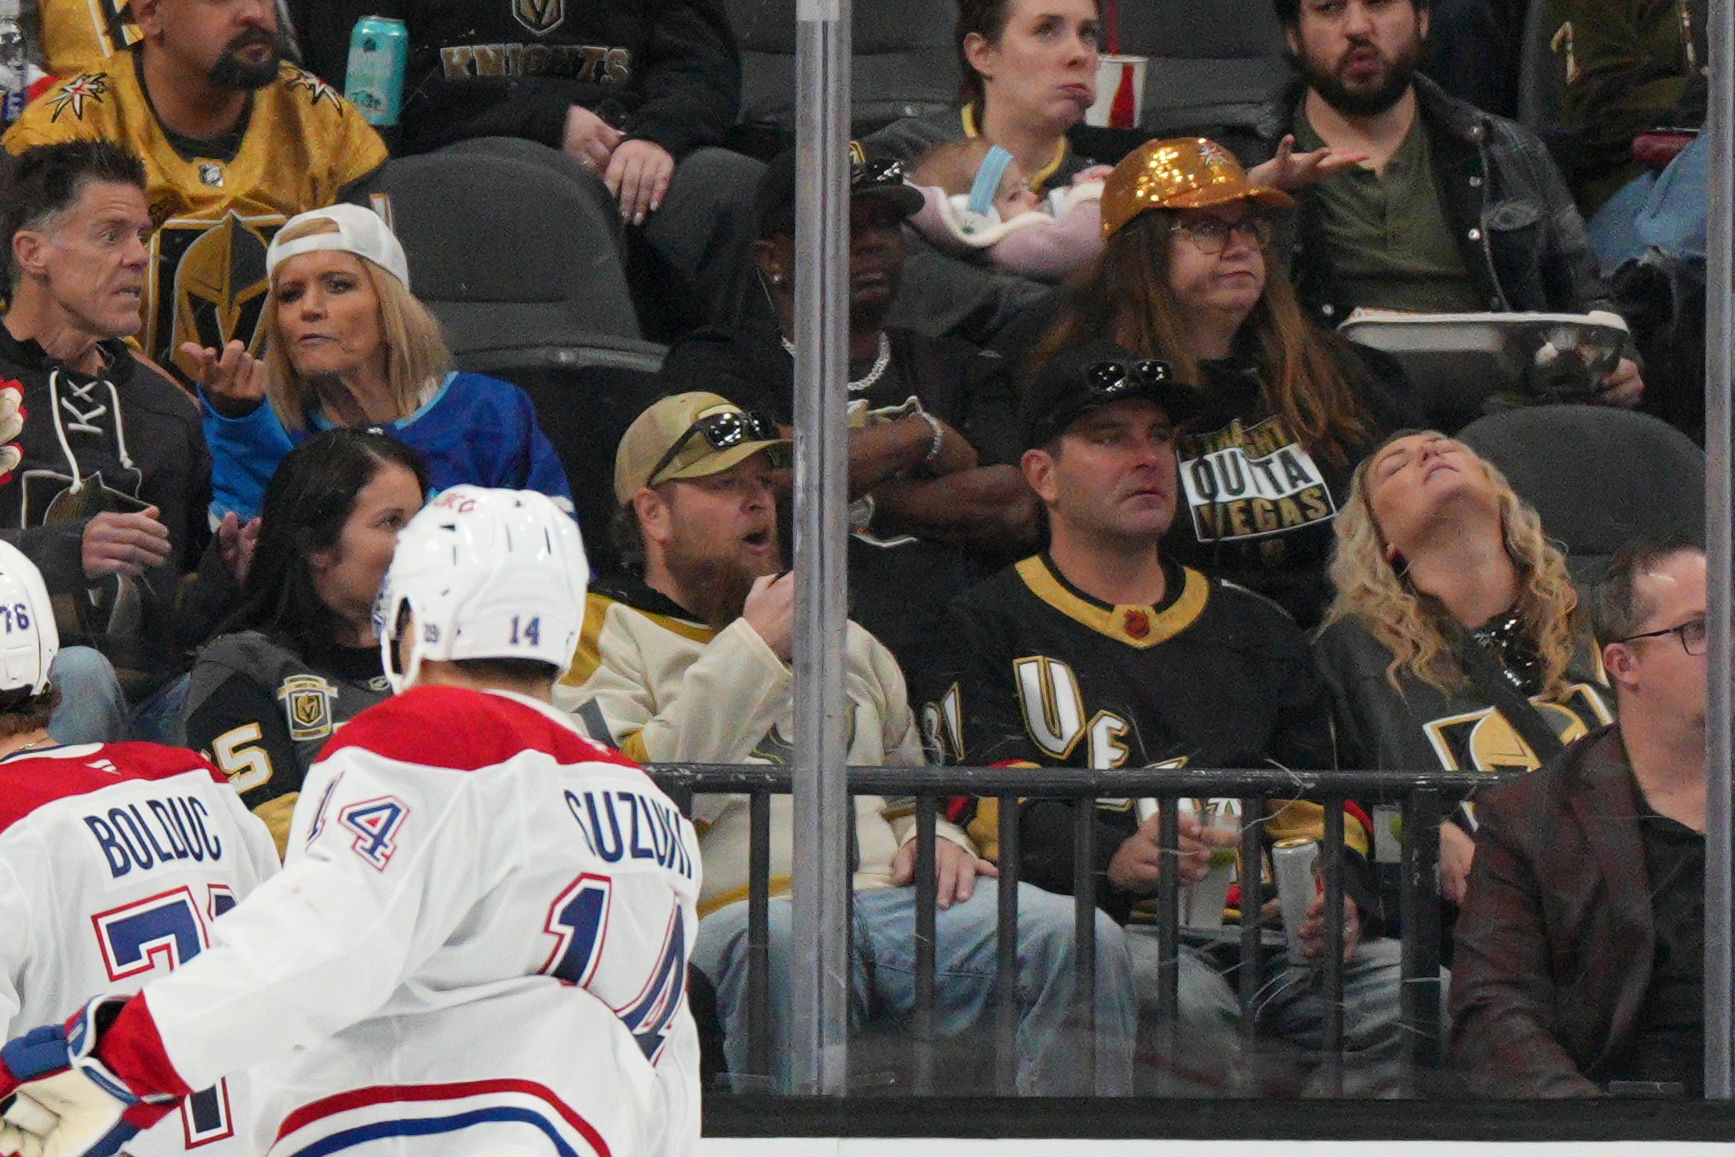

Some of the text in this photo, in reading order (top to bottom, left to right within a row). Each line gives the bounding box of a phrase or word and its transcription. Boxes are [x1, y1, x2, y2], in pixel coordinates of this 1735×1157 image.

[510, 615, 541, 647] 14
[201, 721, 274, 795] 5
[83, 795, 223, 879] BOLDUC
[304, 770, 412, 872] 14
[536, 872, 689, 1069] 14
